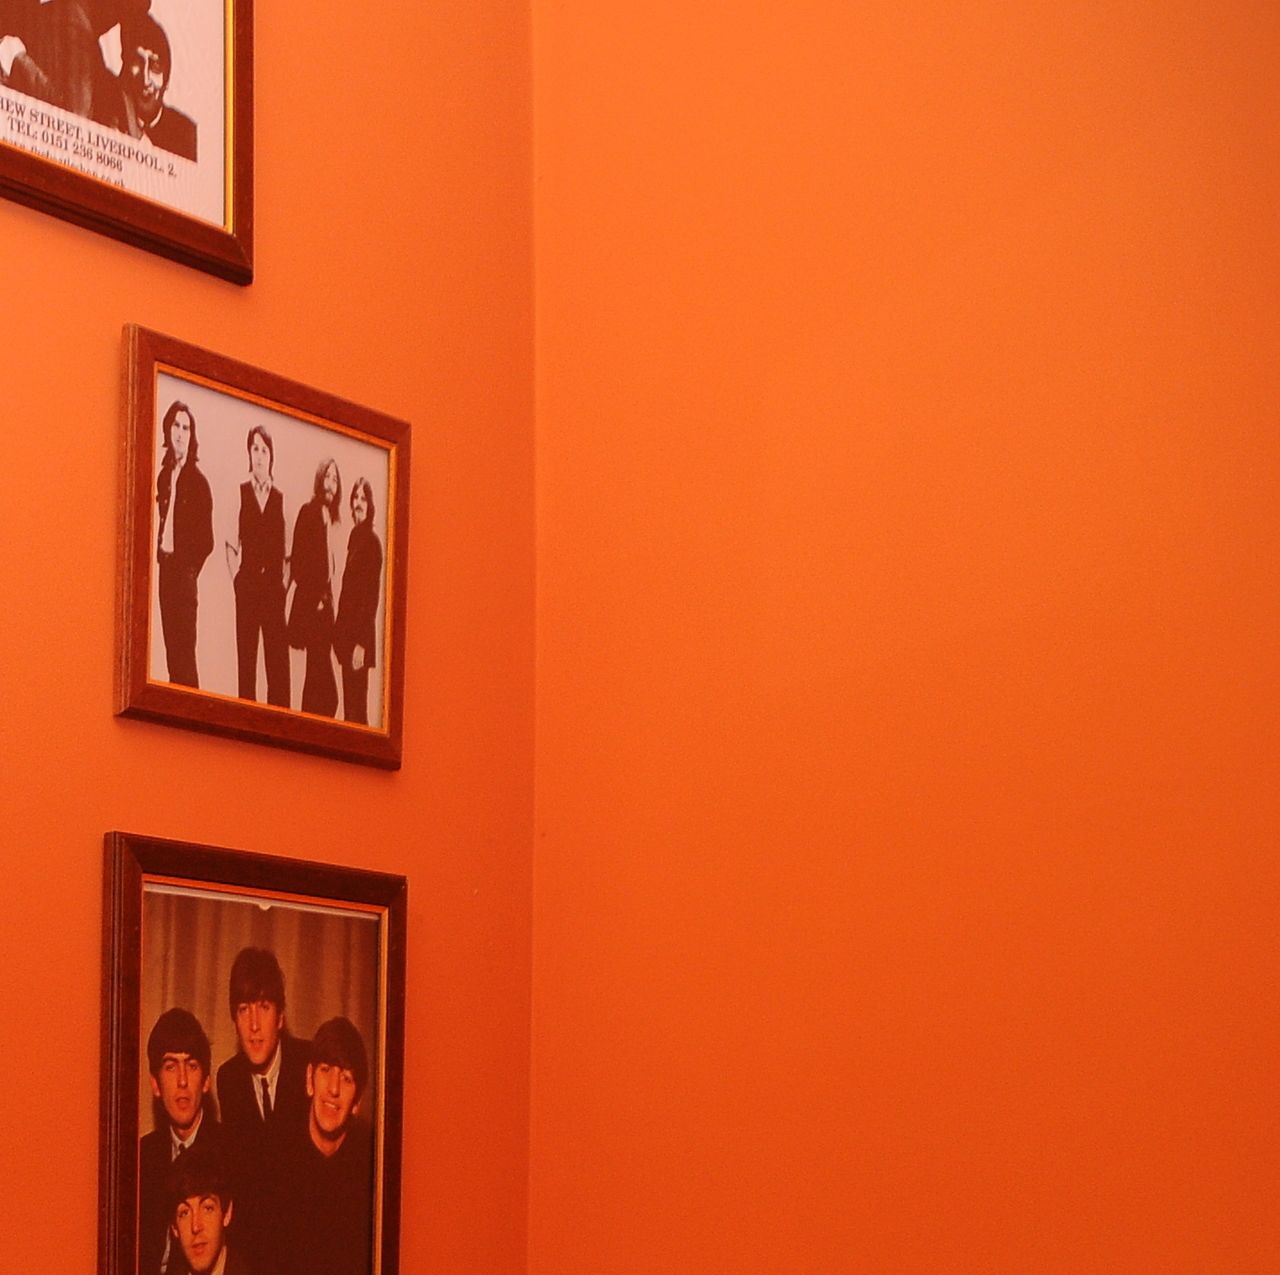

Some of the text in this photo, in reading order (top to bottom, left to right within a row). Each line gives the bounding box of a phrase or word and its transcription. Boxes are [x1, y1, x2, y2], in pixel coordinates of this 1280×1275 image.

[6, 116, 124, 173] TEL: 0151 236 8066
[29, 108, 85, 140] STREET,
